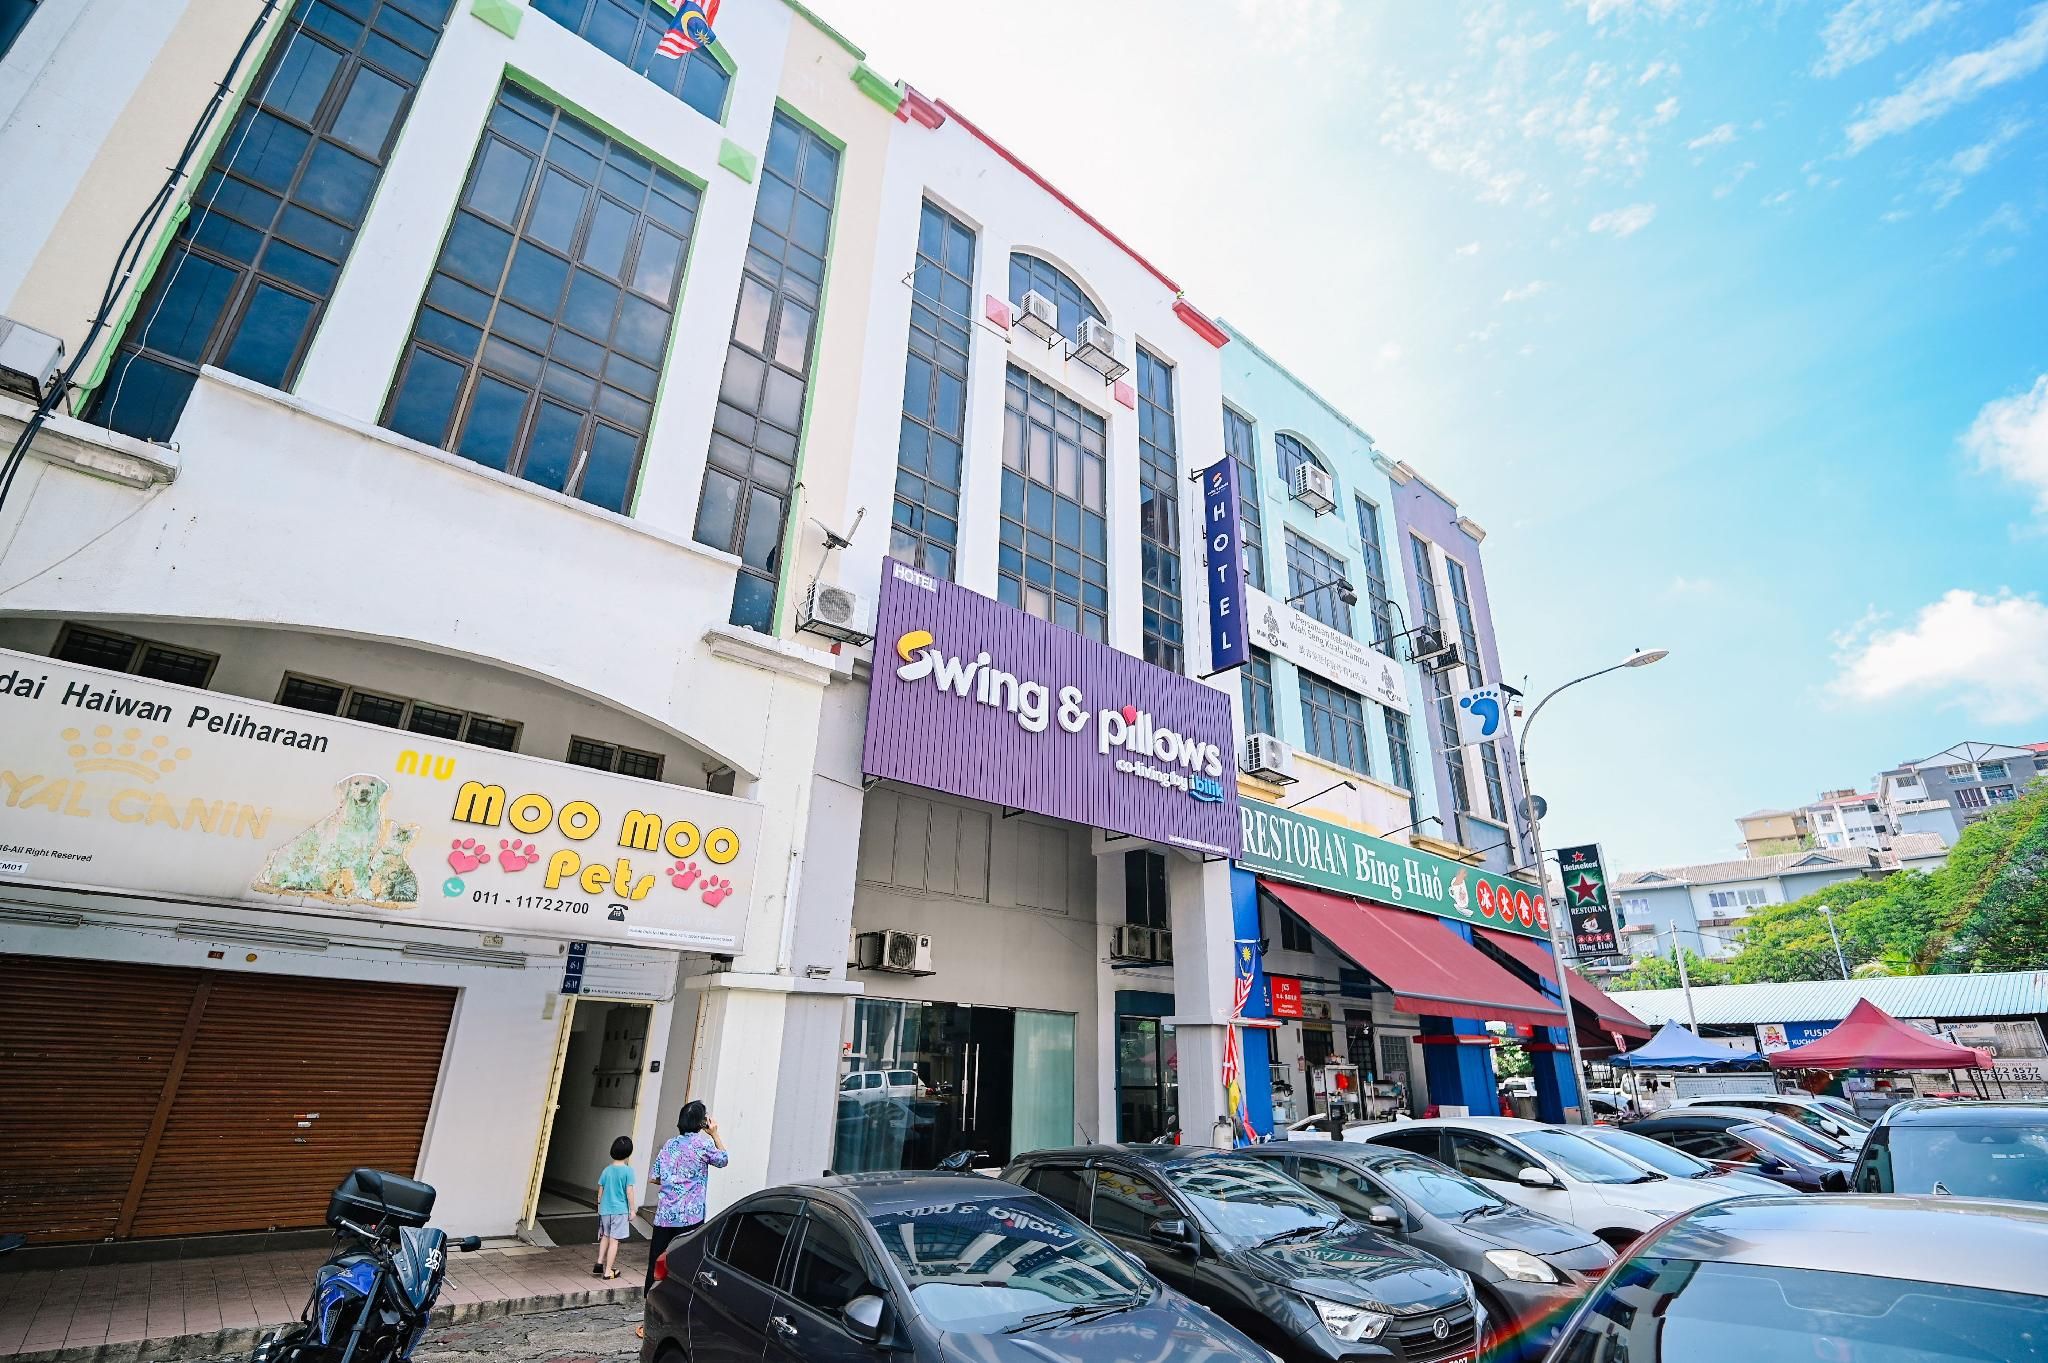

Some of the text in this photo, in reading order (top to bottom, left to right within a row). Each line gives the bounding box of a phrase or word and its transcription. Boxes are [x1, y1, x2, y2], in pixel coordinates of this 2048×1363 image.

[892, 562, 937, 593] HOTEL
[1213, 502, 1232, 650] HOTEL
[61, 681, 173, 723] Haiwan
[187, 706, 329, 753] Peliharaan
[896, 630, 1223, 777] Swing & pillows
[25, 847, 50, 857] Right
[51, 850, 93, 862] Reserved
[1240, 806, 1349, 877] RESTORAN
[544, 849, 656, 900] Pets
[1562, 861, 1598, 872] Heineken
[472, 890, 499, 905] 011
[1478, 884, 1548, 927] 冰火食堂
[1570, 904, 1608, 915] RESTORAN
[2012, 1066, 2039, 1074] 4577
[2014, 1073, 2042, 1081] 8875
